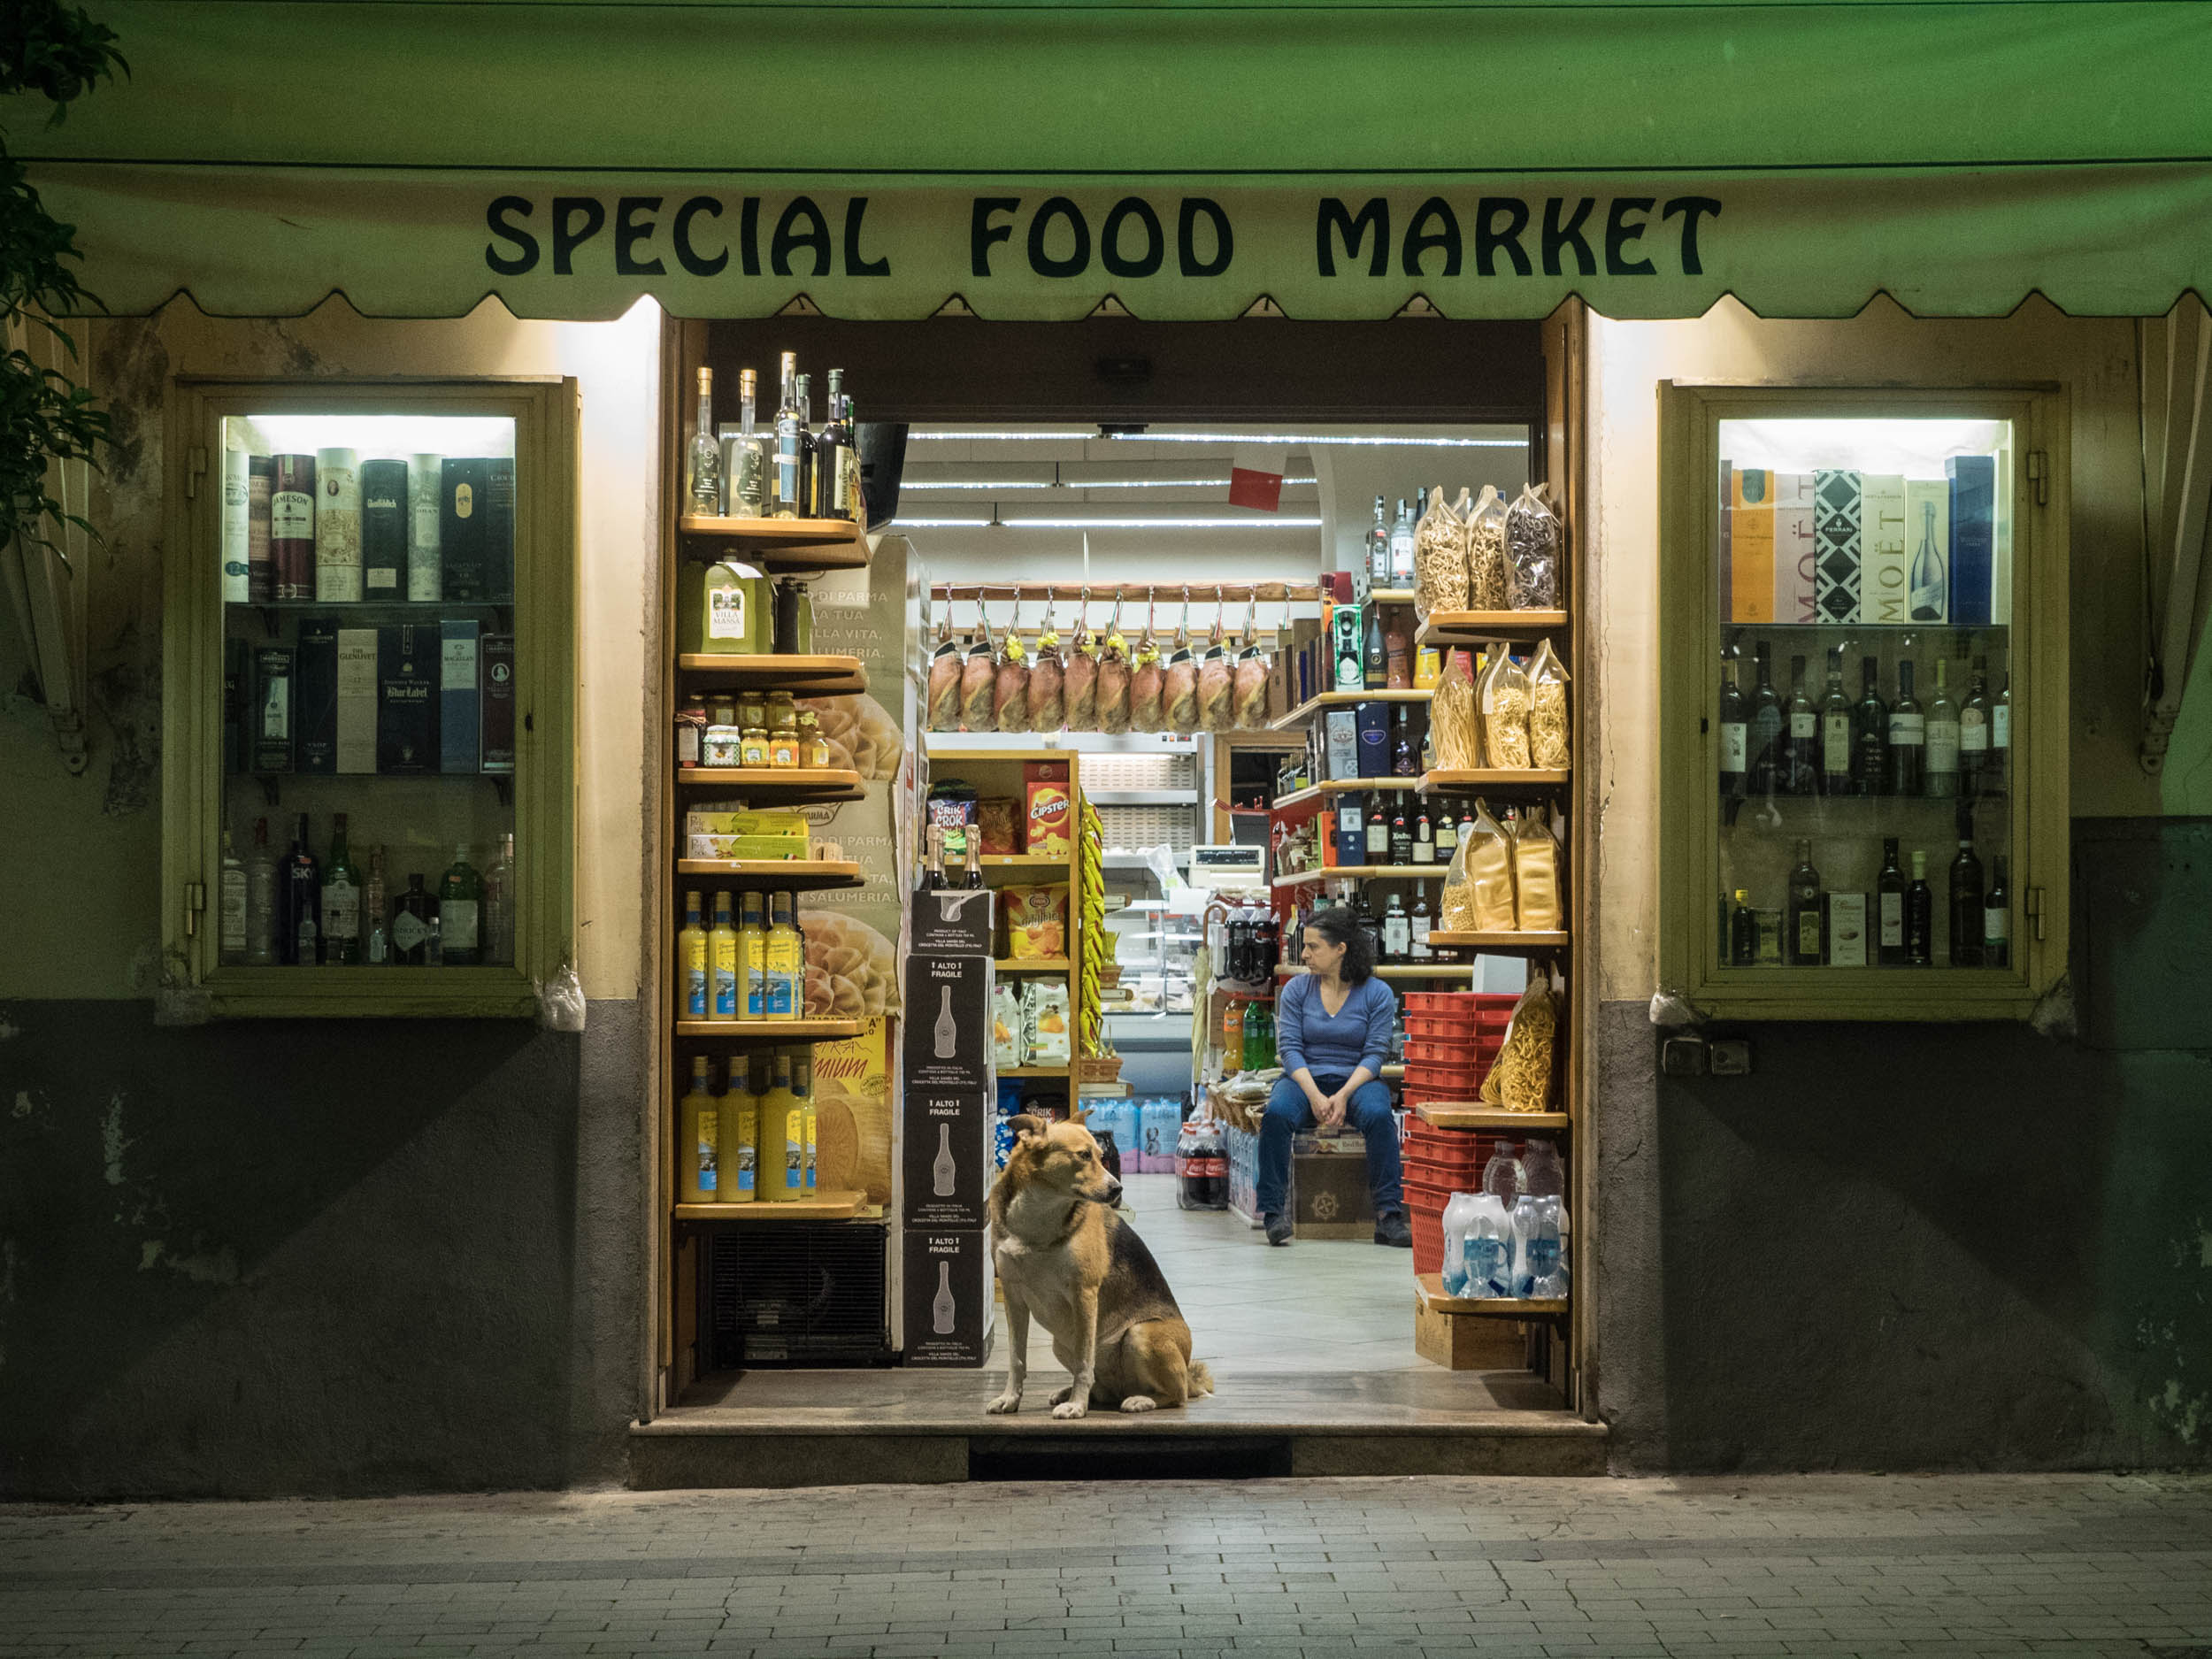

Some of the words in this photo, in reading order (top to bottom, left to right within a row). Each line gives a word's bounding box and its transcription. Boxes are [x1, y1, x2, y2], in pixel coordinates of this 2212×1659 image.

[486, 196, 890, 276] SPECIAL
[972, 196, 1233, 278] FOOD
[1317, 196, 1722, 276] MARKET
[273, 494, 308, 505] JAMESON
[1874, 511, 1904, 623] MOËT
[818, 591, 833, 602] DI
[838, 590, 888, 602] PARMA
[833, 610, 864, 620] TUA
[845, 629, 882, 641] VITA,
[339, 652, 376, 661] GLENLIVET
[937, 806, 962, 815] CRIK
[1030, 799, 1070, 819] CIPSTER
[935, 815, 964, 827] CROK
[870, 873, 893, 886] TA.
[809, 892, 895, 902] SALUMERIA.
[1032, 1108, 1052, 1117] CRIK
